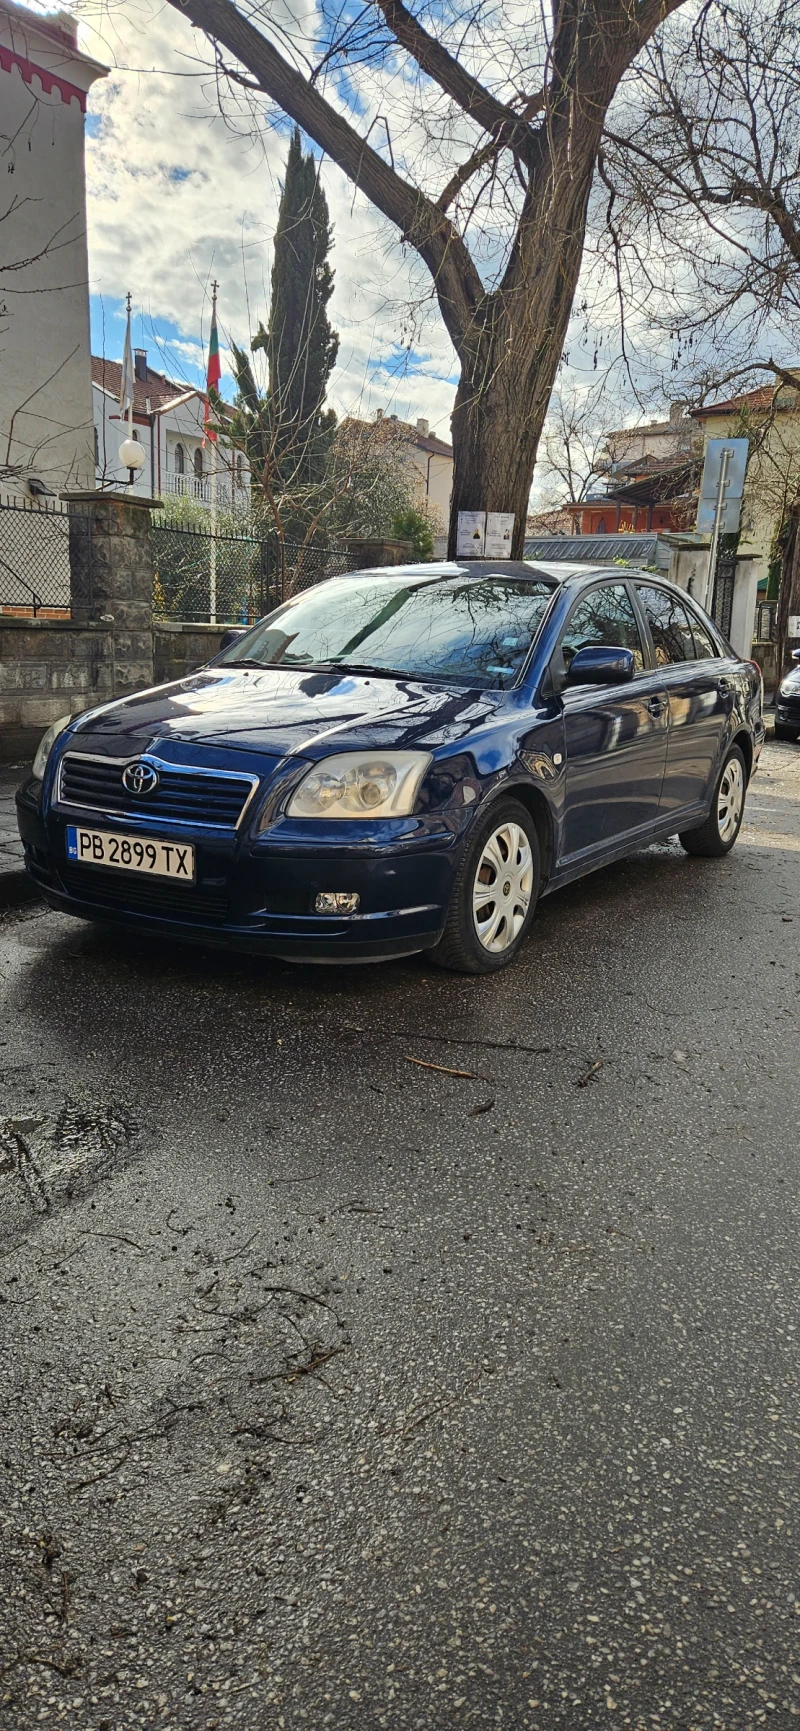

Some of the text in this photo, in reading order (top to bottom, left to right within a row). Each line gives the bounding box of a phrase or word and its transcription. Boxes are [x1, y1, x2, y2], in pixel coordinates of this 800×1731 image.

[69, 847, 77, 855] BG
[80, 833, 188, 875] PB 2899 TX
